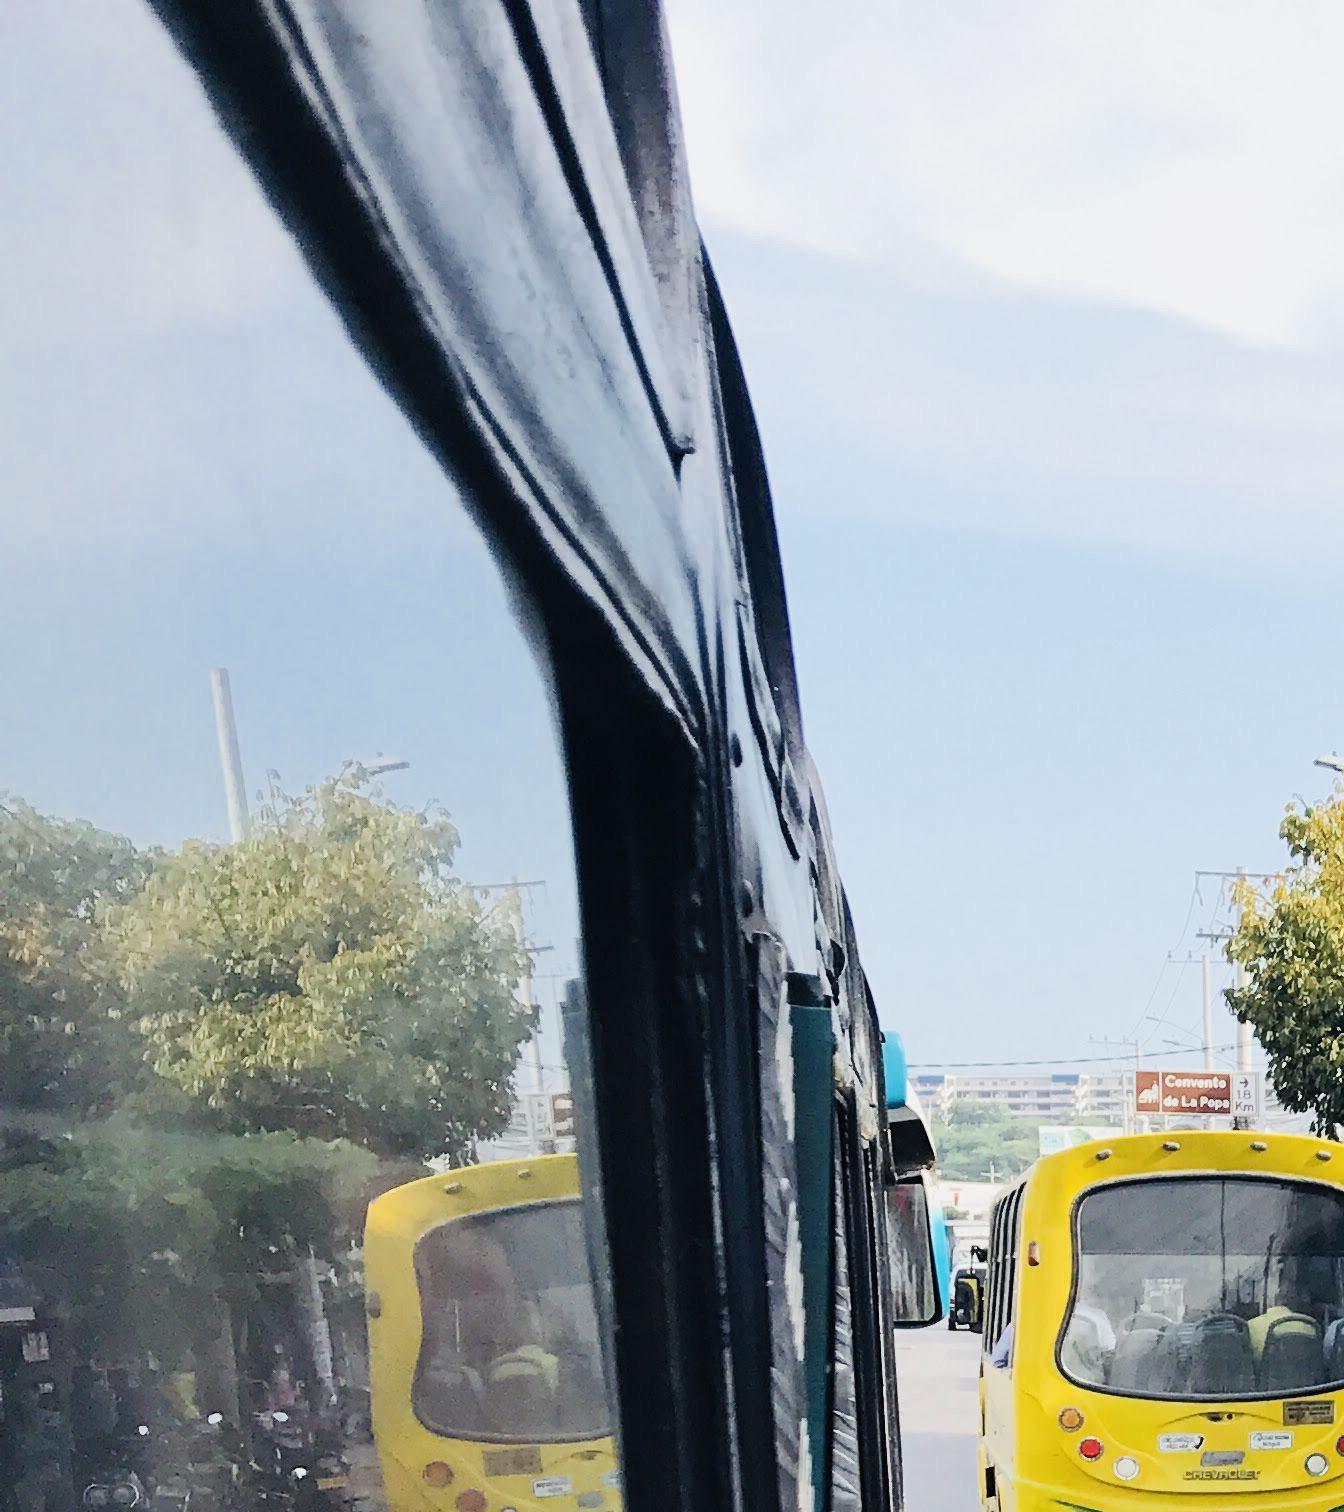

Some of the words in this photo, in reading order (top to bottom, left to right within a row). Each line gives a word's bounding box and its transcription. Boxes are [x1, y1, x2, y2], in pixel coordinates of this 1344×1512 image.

[1164, 1074, 1227, 1089] Convento
[1163, 1095, 1180, 1107] de
[1181, 1095, 1198, 1108] La
[1199, 1096, 1230, 1111] Popa
[1235, 1101, 1254, 1112] Km
